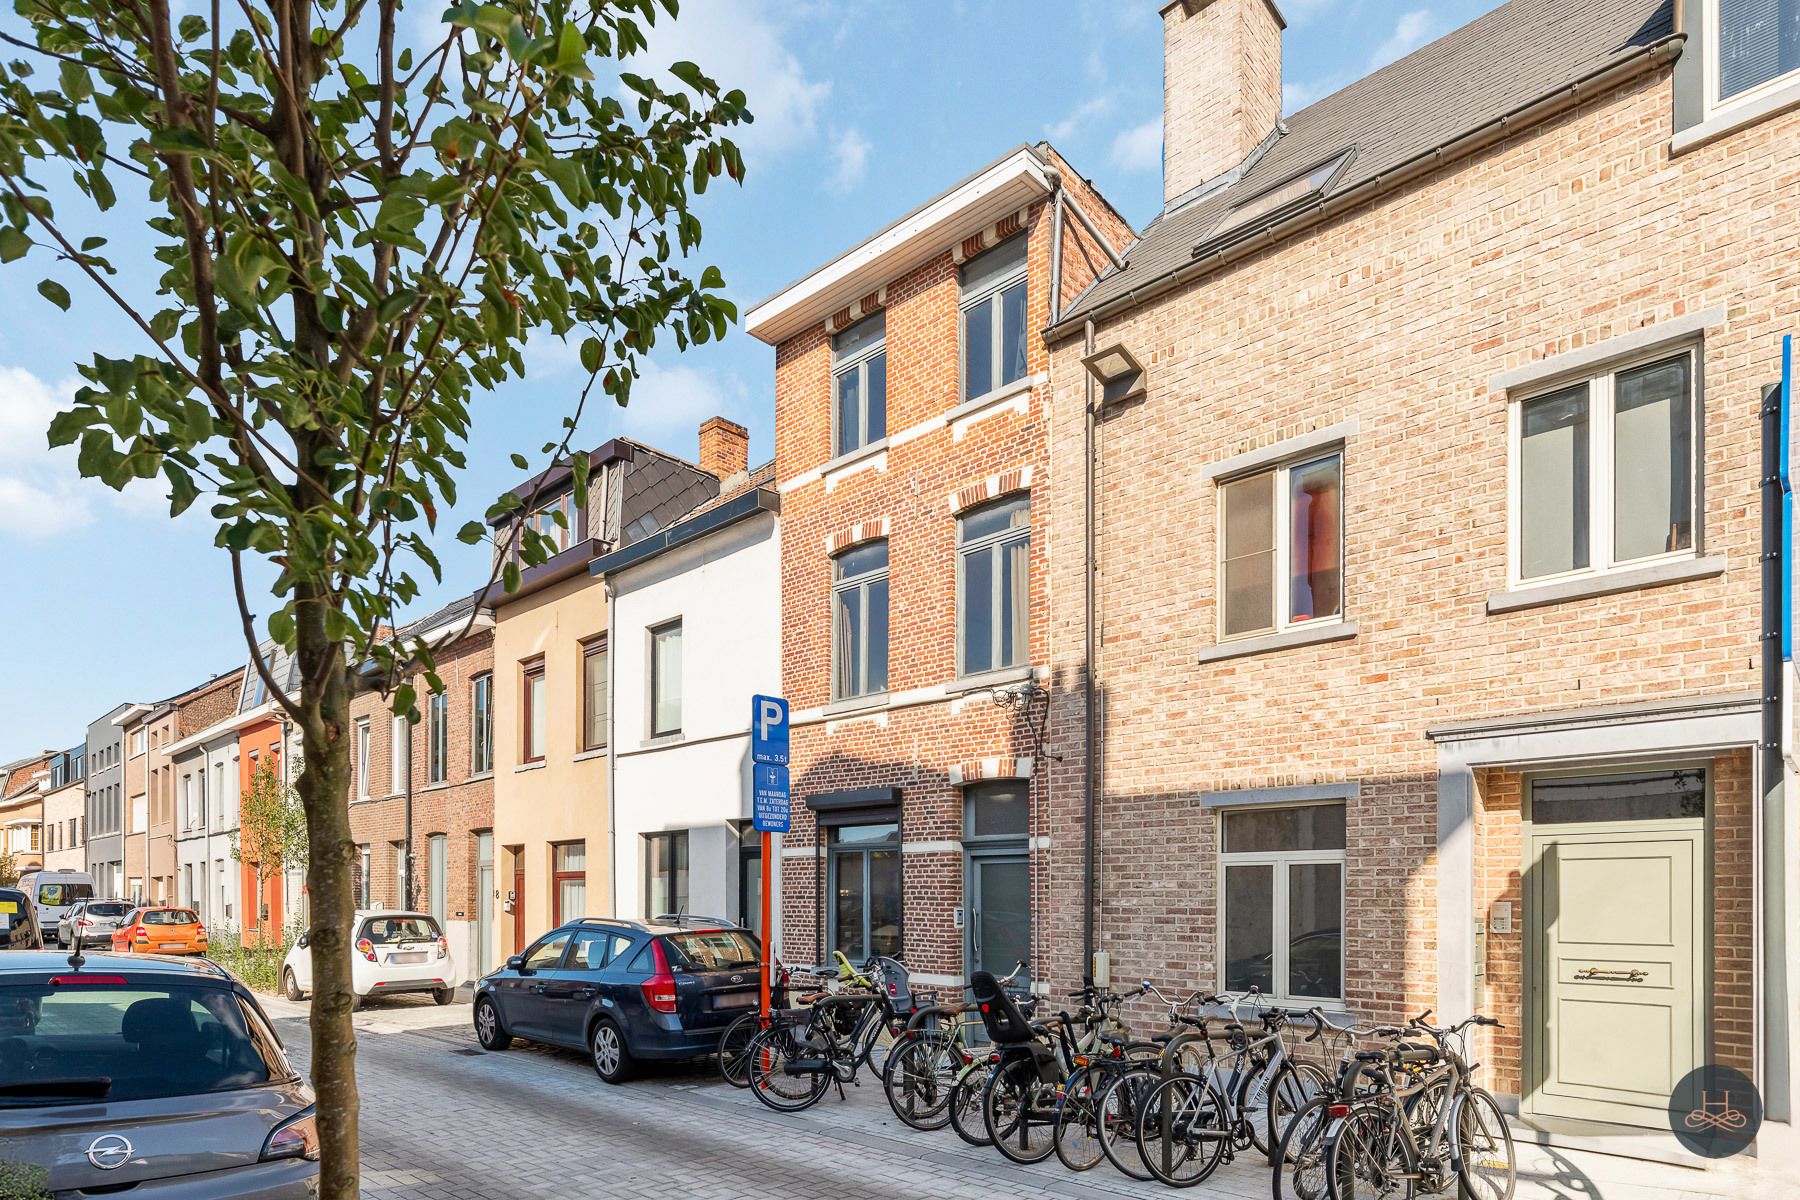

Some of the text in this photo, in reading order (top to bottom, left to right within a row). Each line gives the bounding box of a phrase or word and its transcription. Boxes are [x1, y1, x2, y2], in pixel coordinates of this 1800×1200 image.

[760, 699, 783, 741] P
[772, 805, 780, 813] TOT
[758, 812, 788, 820] UITGEZONDERD
[495, 889, 500, 900] 8
[1253, 1076, 1271, 1101] TRIBAN
